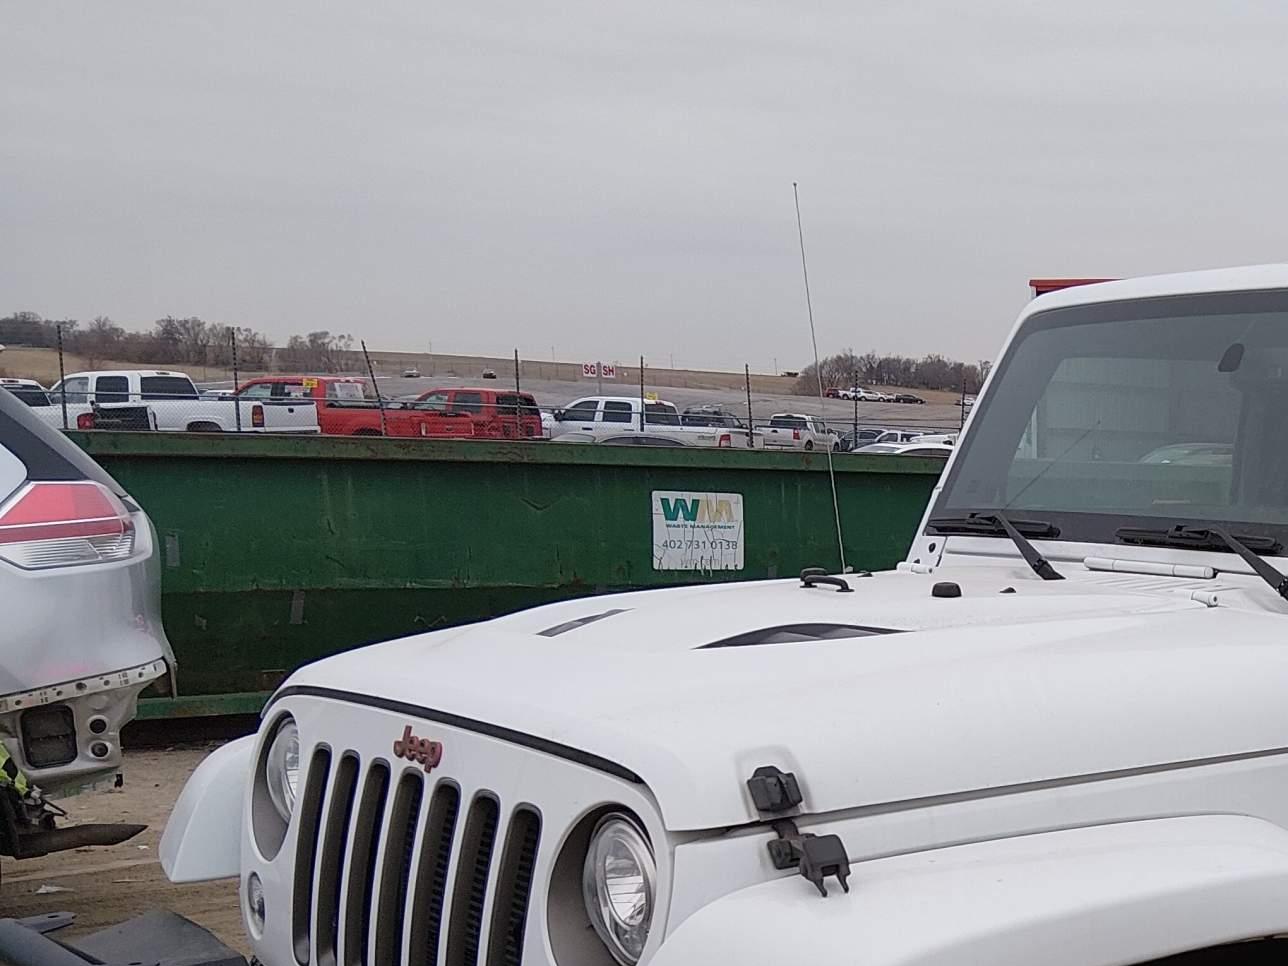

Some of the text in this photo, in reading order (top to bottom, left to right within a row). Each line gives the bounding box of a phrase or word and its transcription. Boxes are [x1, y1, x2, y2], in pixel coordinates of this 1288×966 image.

[583, 364, 597, 375] SG
[602, 365, 615, 376] SH
[660, 497, 735, 522] WM
[662, 540, 738, 550] 402 731 0138
[393, 724, 443, 775] Jeep
